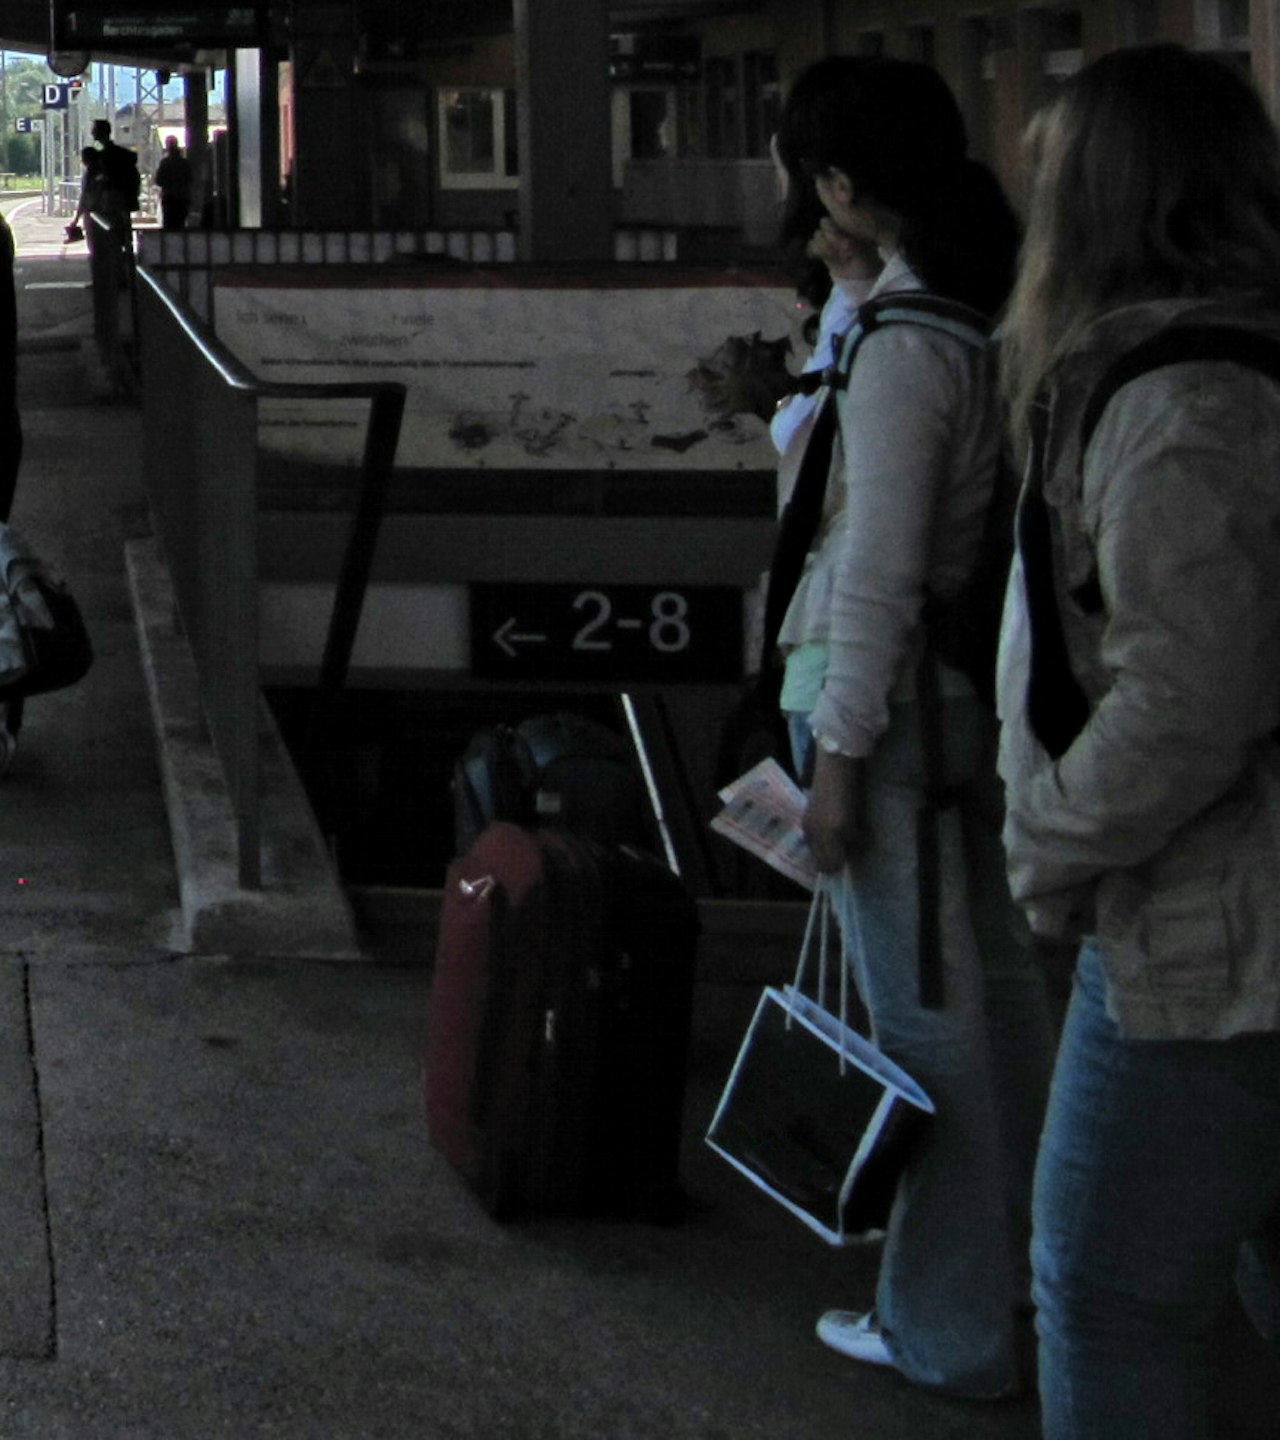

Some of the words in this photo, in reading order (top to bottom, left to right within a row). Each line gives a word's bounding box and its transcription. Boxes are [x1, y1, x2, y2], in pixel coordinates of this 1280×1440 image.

[66, 11, 78, 33] 1
[45, 85, 60, 104] D
[16, 118, 27, 132] E
[571, 589, 691, 654] 2-8
